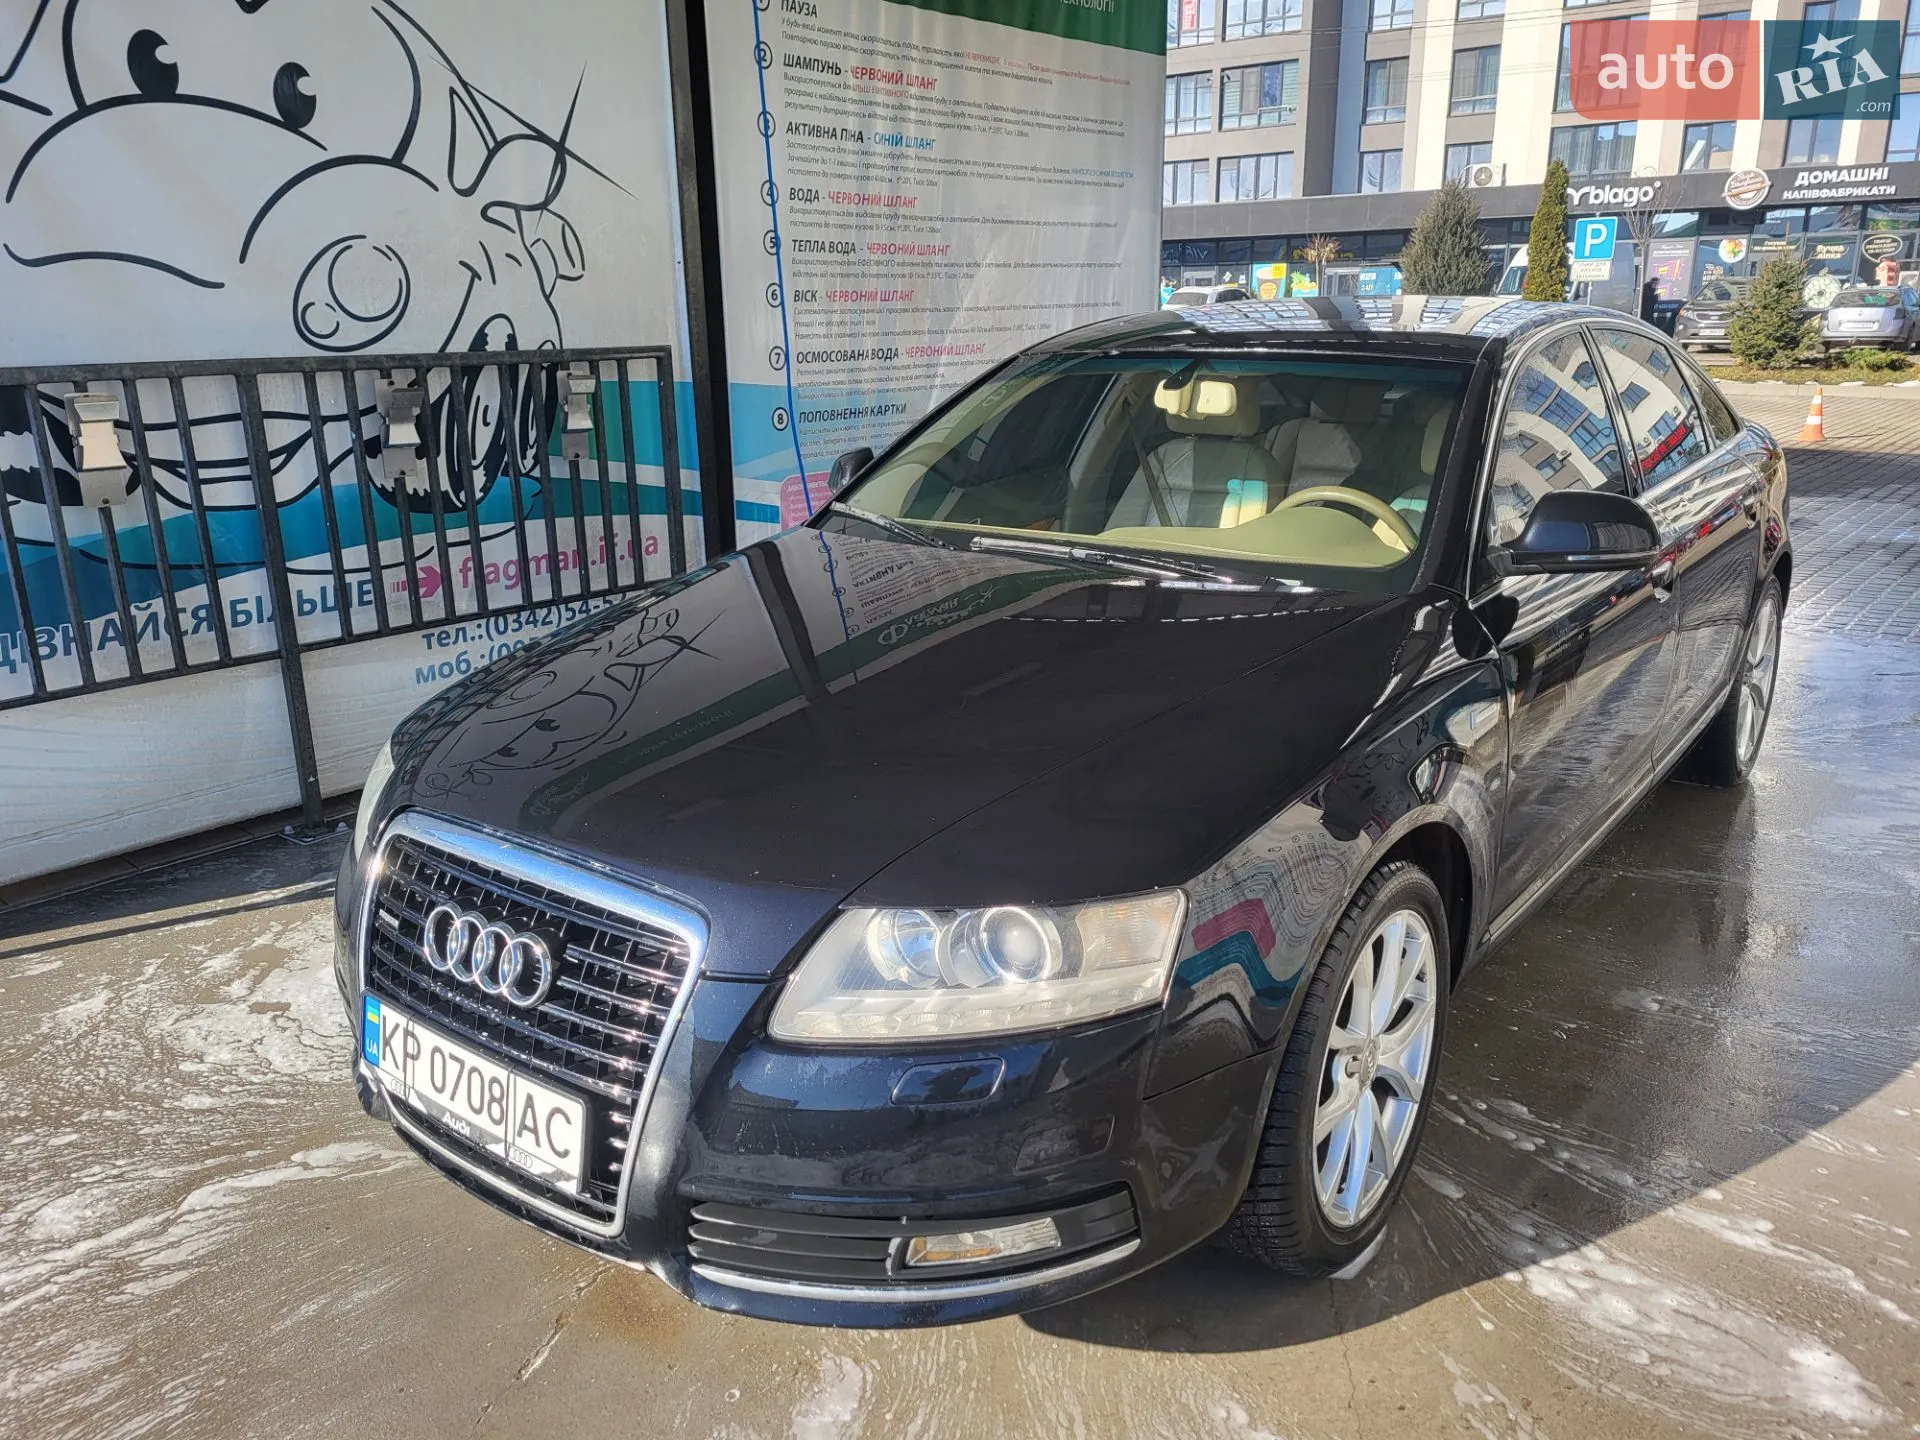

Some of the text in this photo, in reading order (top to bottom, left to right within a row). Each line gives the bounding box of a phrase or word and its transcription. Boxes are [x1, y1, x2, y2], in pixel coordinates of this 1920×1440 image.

[781, 0, 817, 18] ПАУЗА
[783, 53, 841, 76] ШАМПУНЬ
[850, 65, 903, 83] ЧЕРВОНИЙ
[906, 75, 938, 90] ШЛАНГ
[786, 122, 837, 140] АКТИВНА
[874, 132, 902, 147] СИНІЙ
[905, 136, 936, 150] ШЛАНГ
[1795, 167, 1889, 187] ДОМАШНІ
[789, 187, 819, 206] ВОДА
[828, 191, 881, 206] ЧЕРВОНИЙ
[883, 195, 918, 208] ШЛАНГ
[1783, 185, 1896, 200] НАПІВФАБРИКАТИ
[792, 239, 826, 253] ТЕПЛА
[829, 241, 856, 256] ВОДА
[867, 241, 915, 255] ЧЕРВОНИЙ
[917, 244, 950, 256] ШЛАНГ
[1584, 223, 1608, 256] P
[771, 289, 778, 301] 6
[794, 290, 818, 303] ВІСК
[826, 288, 878, 303] ЧЕРВОНИЙ
[880, 290, 915, 302] ШЛАНГ
[774, 352, 781, 365] 7
[796, 348, 869, 364] ОСМОСОВАНА
[871, 347, 899, 361] ВОДА
[905, 343, 953, 359] ЧЕРВОНИЙ
[955, 343, 986, 355] ШЛАНГ
[778, 403, 907, 425] 8 ПОПОВНЕННЯ КАРТКИ
[459, 533, 659, 590] fagman.i.ua
[229, 579, 373, 628] БІЬШЕ
[366, 1039, 379, 1057] UA
[382, 1015, 572, 1159] KP 0708 AC
[442, 1111, 471, 1136] Audi
